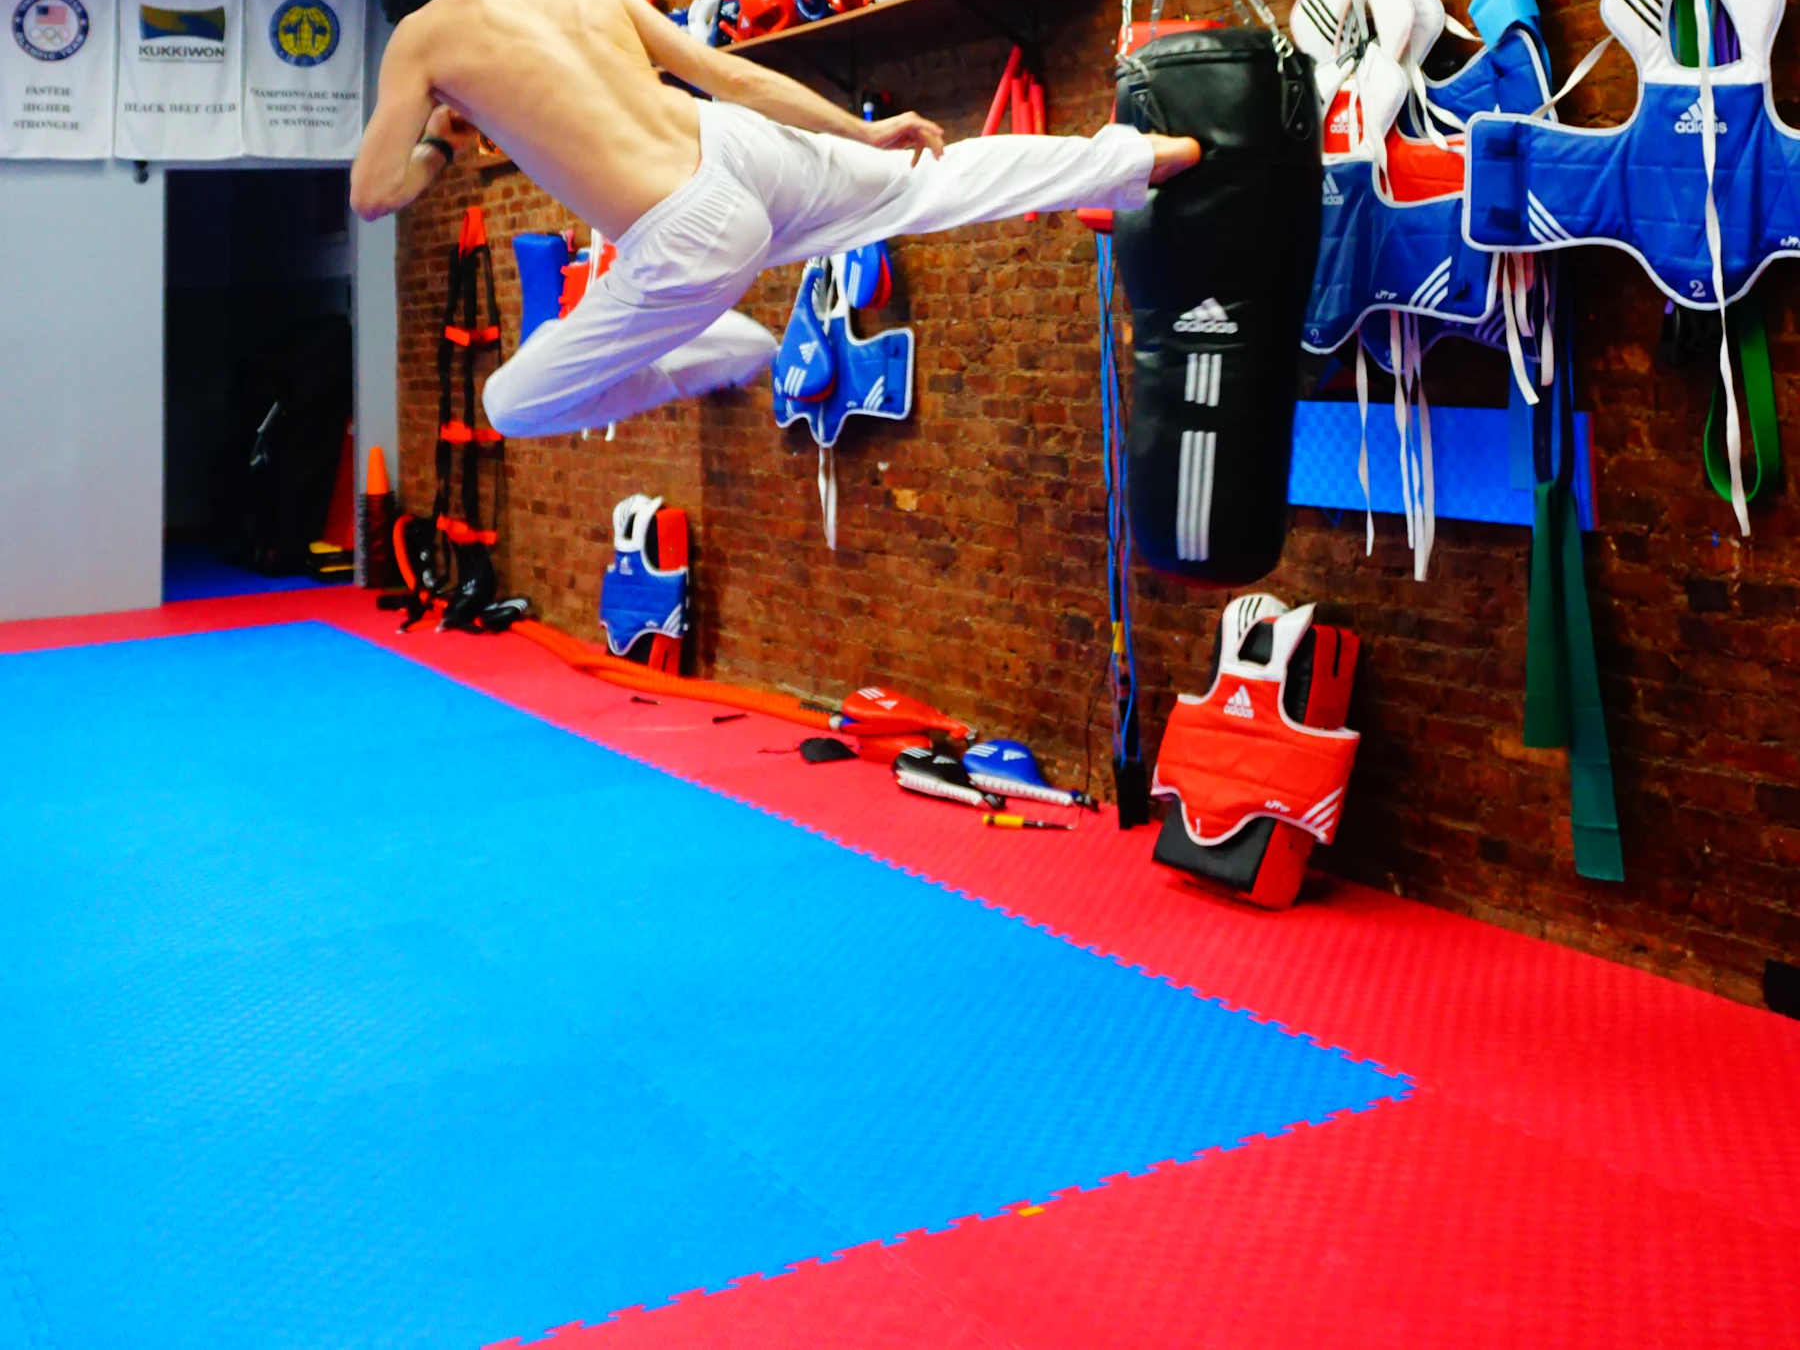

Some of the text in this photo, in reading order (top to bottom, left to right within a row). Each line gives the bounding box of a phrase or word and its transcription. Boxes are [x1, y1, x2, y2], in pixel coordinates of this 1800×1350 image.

[138, 45, 225, 58] KUKKIWON
[25, 85, 70, 96] FASTER
[23, 102, 71, 113] HIGHER
[124, 103, 236, 114] BLACK BELT CLUB
[13, 120, 80, 130] STRONGER
[1689, 279, 1706, 298] 2
[1172, 320, 1239, 335] adidas
[1223, 703, 1255, 719] adidas
